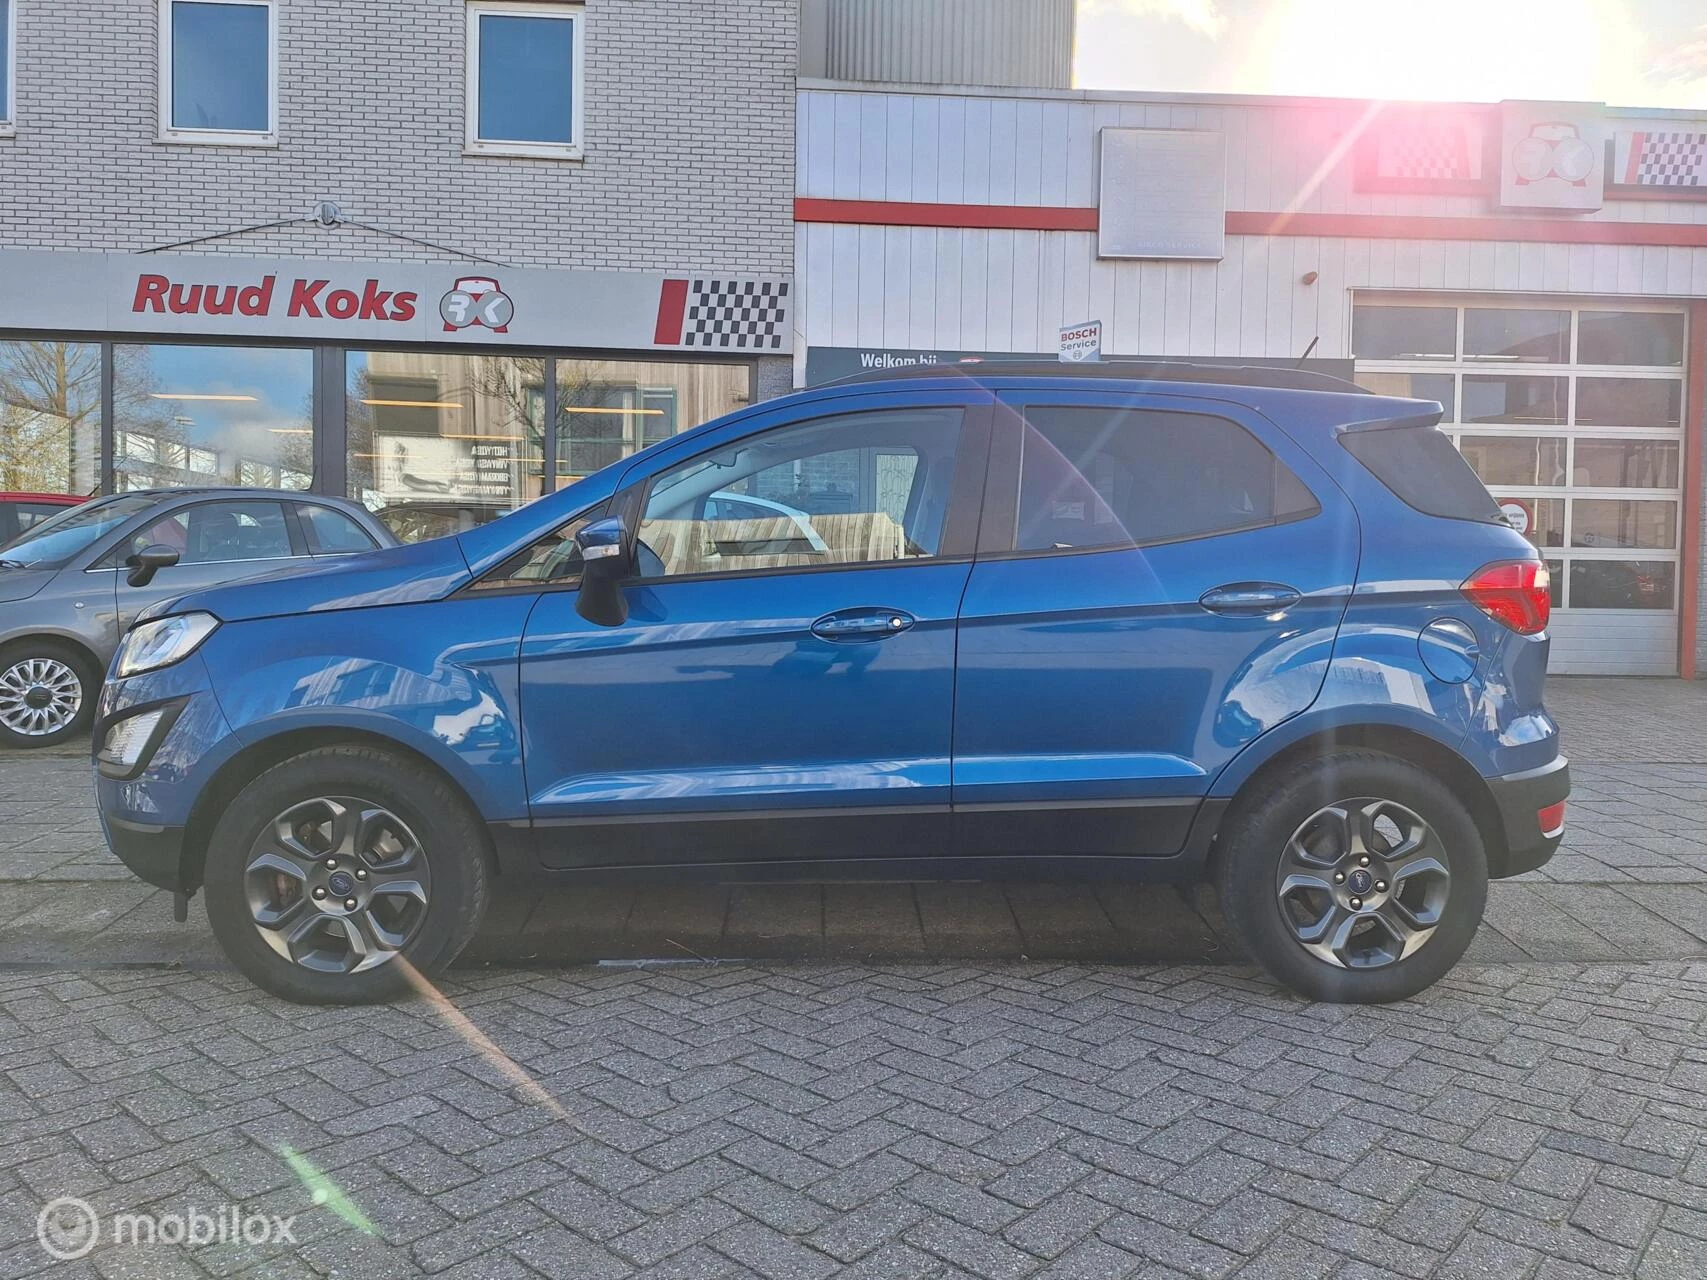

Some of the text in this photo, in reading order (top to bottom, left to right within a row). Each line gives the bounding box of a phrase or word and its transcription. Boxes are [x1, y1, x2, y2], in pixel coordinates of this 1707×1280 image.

[132, 273, 418, 321] Ruud Koks
[1061, 328, 1097, 342] BOSCH
[1060, 340, 1097, 351] Service
[861, 353, 916, 368] Welkom
